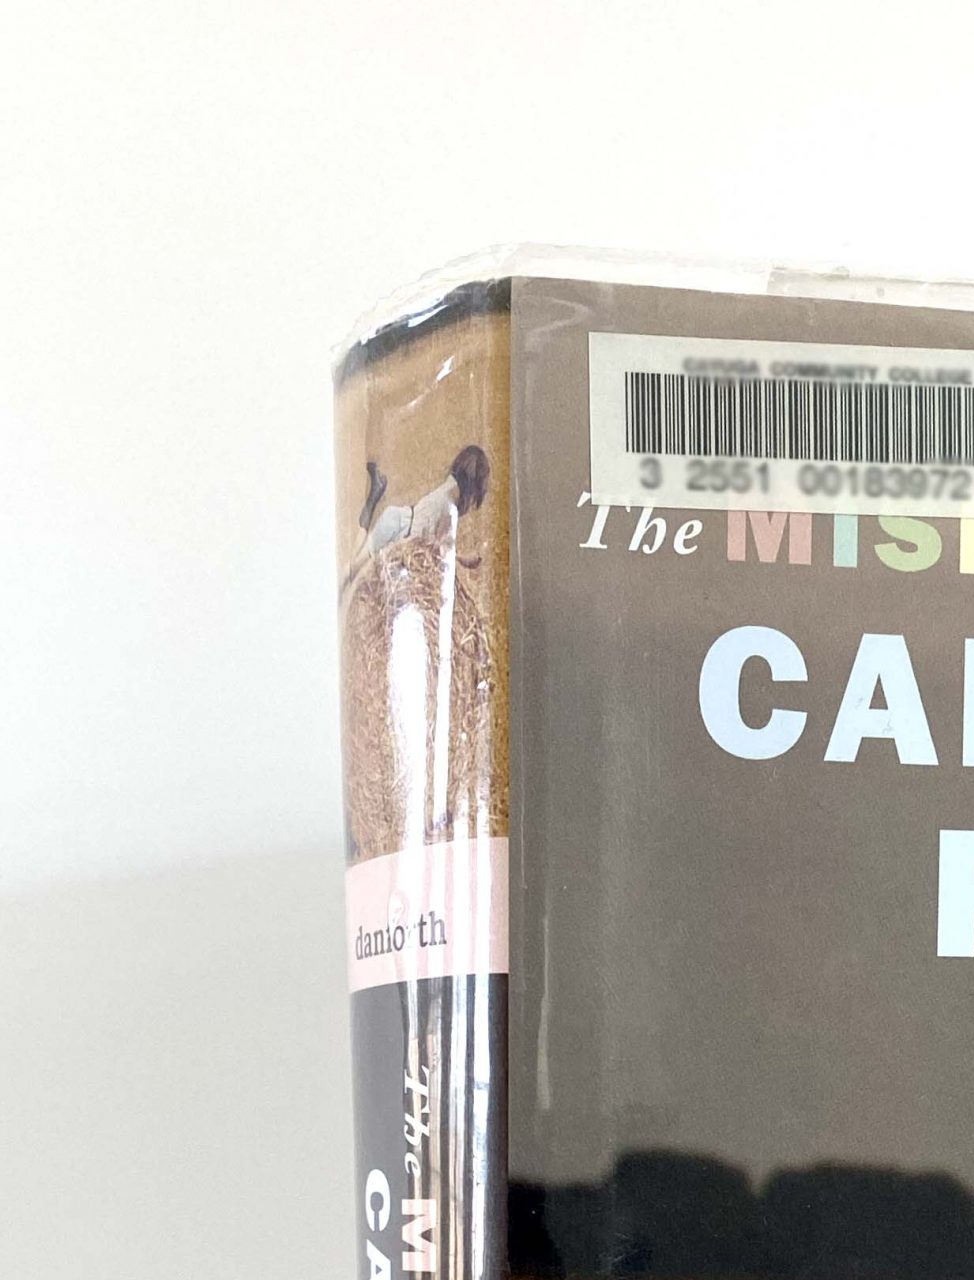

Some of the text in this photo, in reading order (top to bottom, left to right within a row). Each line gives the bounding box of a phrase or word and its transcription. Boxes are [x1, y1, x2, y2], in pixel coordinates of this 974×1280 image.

[638, 458, 663, 490] 3
[686, 460, 771, 494] 2551
[576, 490, 703, 556] The
[404, 1064, 431, 1178] The
